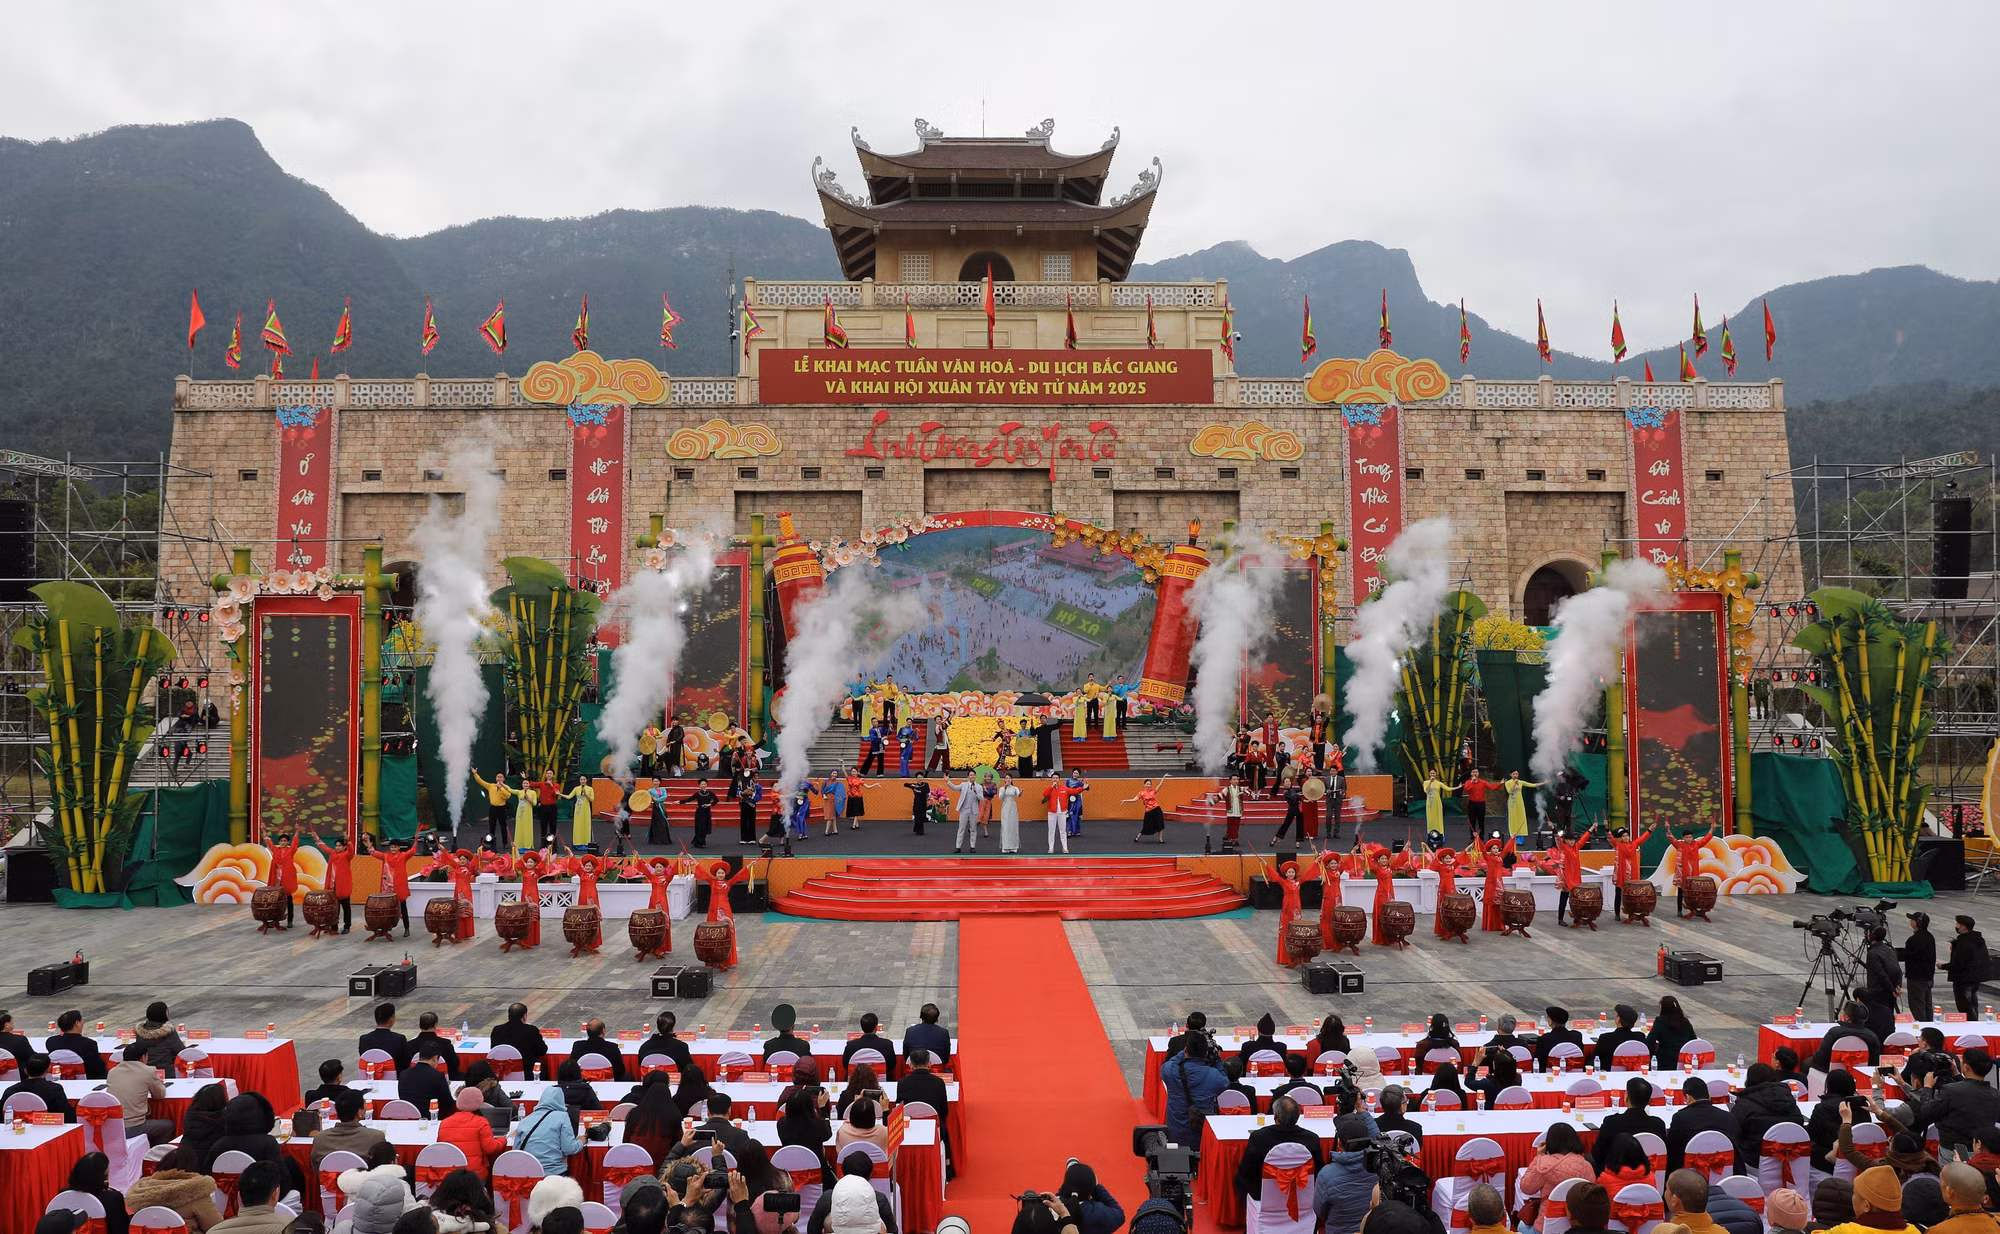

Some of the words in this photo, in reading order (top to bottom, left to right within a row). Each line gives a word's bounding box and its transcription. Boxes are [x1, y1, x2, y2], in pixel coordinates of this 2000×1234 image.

[794, 354, 810, 373] LỄ
[813, 360, 853, 373] KHAI
[857, 360, 891, 376] MẠC
[895, 356, 938, 374] TUẦN
[942, 358, 975, 374] VĂN
[980, 358, 1015, 374] HOÁ
[1029, 361, 1050, 374] DU
[1055, 361, 1088, 376] LỊCH
[1092, 356, 1123, 374] BẮC
[1127, 361, 1178, 374] GIANG
[824, 379, 847, 394] VÀ
[851, 380, 890, 394] KHAI
[894, 378, 923, 397] HỘI
[927, 378, 972, 394] XUÂN
[976, 379, 1006, 395] TÂY
[1009, 380, 1039, 395] YÊN
[1042, 378, 1065, 395] TỬ
[1068, 379, 1104, 395] NĂM
[1108, 381, 1147, 395] 2025
[1354, 457, 1394, 483] Trong
[1363, 517, 1389, 533] Có
